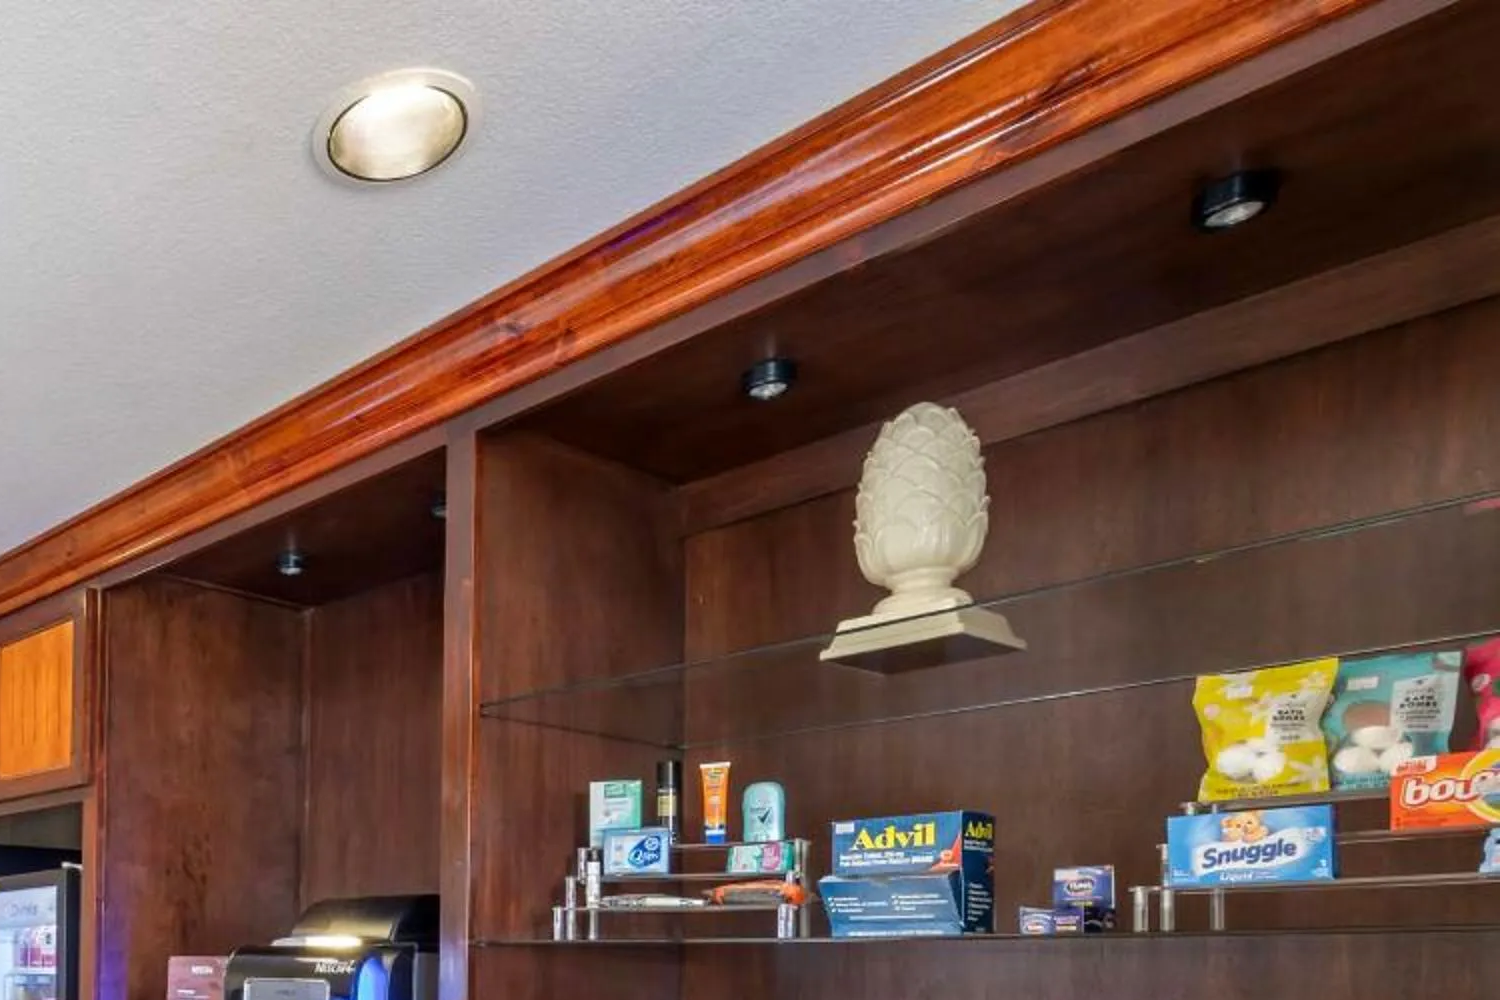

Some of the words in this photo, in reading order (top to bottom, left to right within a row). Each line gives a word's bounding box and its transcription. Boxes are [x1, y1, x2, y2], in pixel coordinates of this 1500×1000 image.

[1404, 770, 1499, 806] bou
[850, 821, 937, 851] Advil
[964, 820, 994, 841] Advil
[1202, 838, 1298, 869] Snuggle
